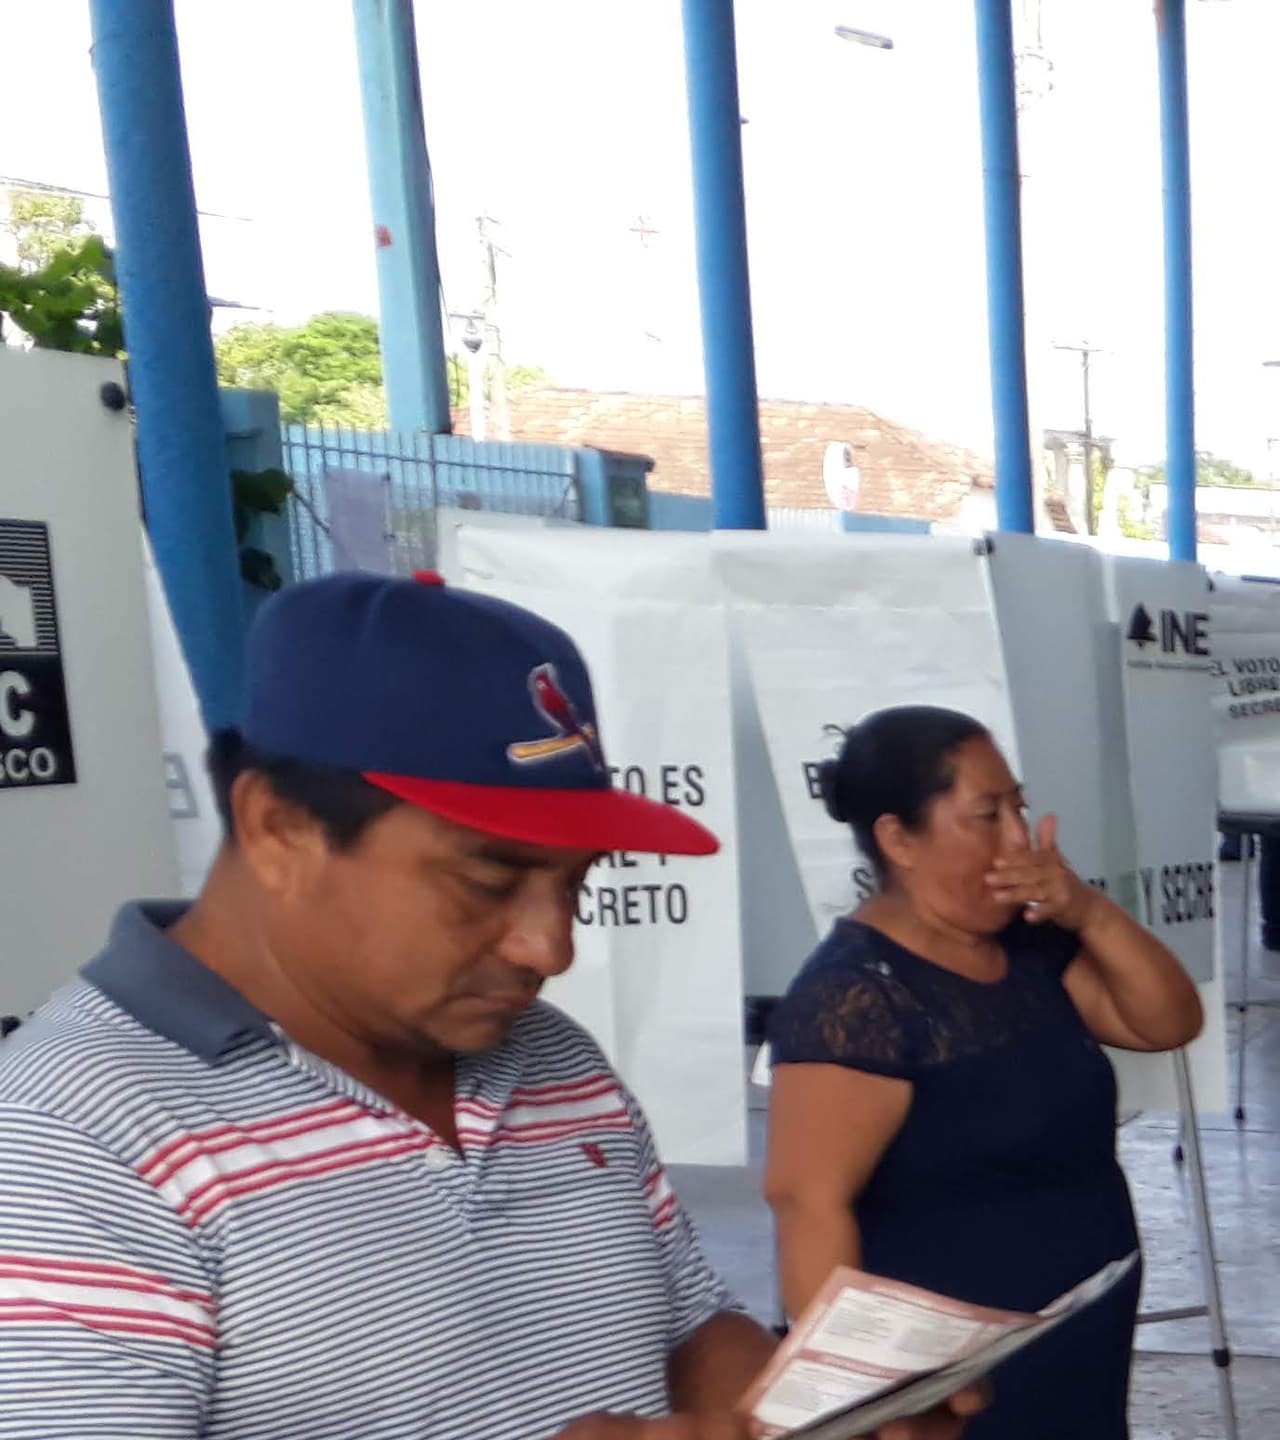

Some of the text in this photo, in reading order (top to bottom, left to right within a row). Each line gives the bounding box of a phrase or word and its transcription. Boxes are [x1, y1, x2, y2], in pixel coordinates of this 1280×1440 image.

[1160, 609, 1211, 656] INE
[1232, 656, 1280, 675] VOTO
[1227, 678, 1280, 697] LIBRE
[0, 746, 56, 781] CO
[661, 765, 704, 807] ES
